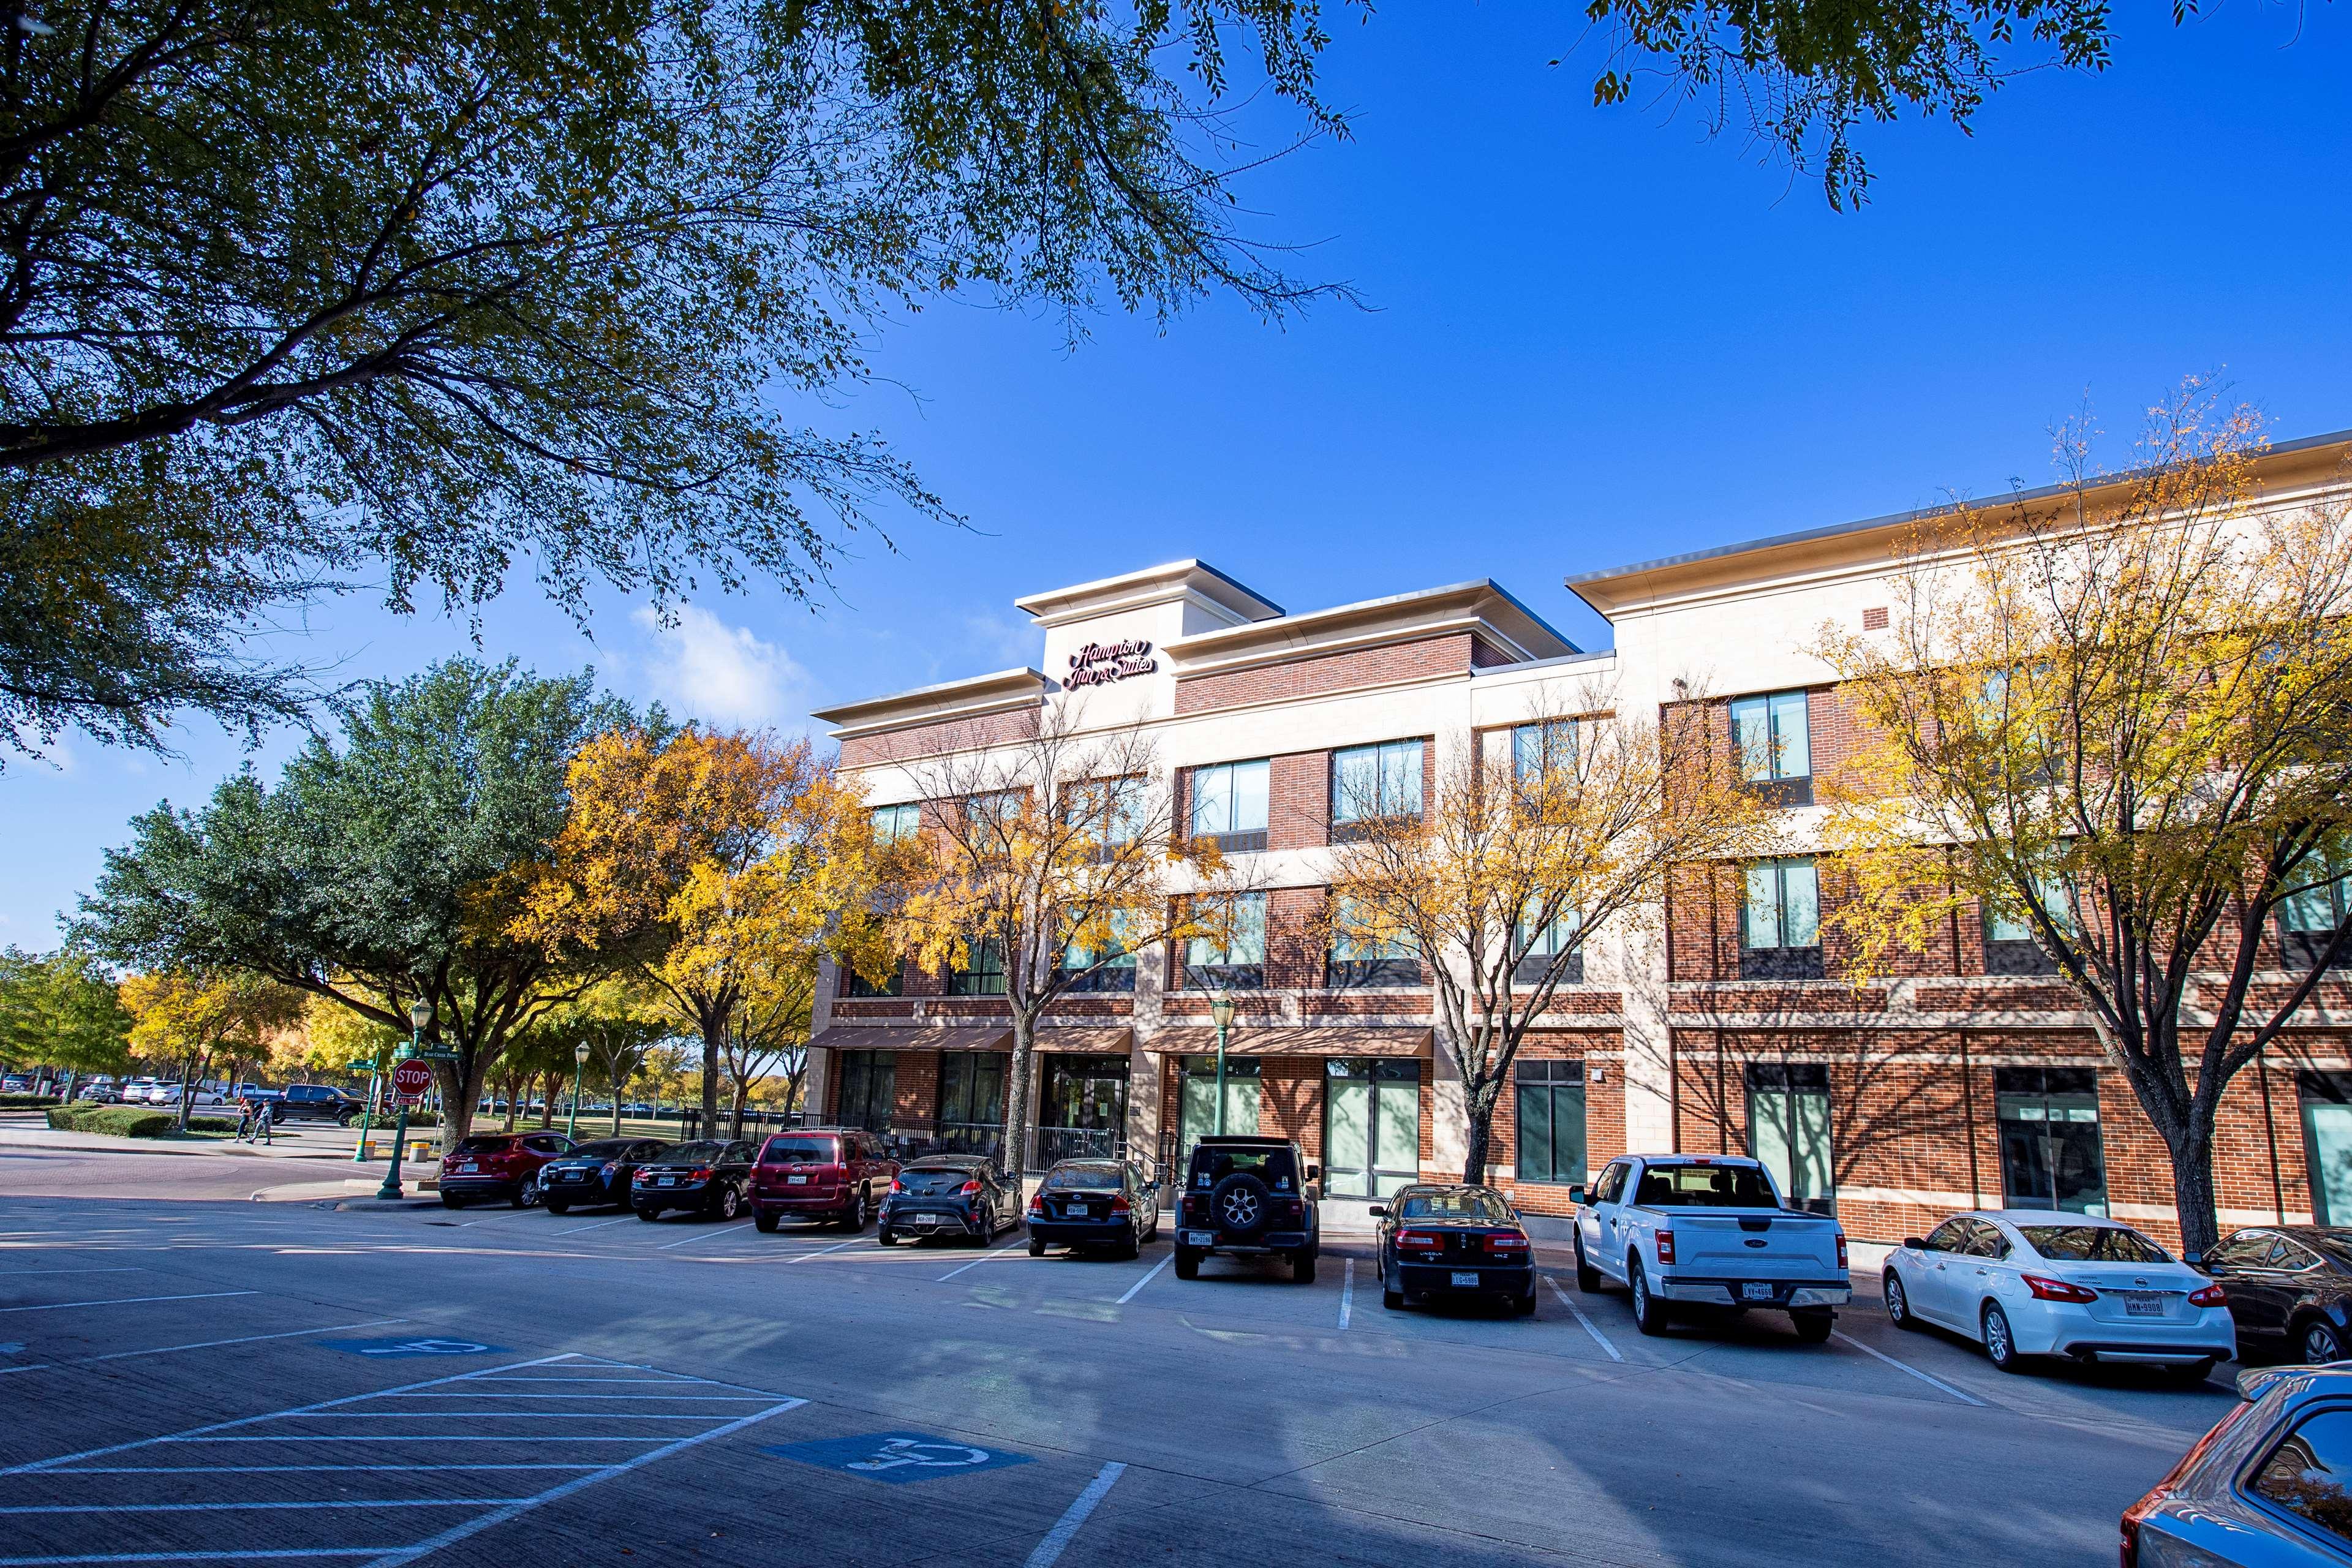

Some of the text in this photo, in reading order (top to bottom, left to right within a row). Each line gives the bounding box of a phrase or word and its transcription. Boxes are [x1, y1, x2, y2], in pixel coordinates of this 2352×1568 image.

[1069, 639, 1149, 669] Hampton
[1061, 657, 1156, 690] Inn & Suites
[397, 1069, 429, 1084] STOP
